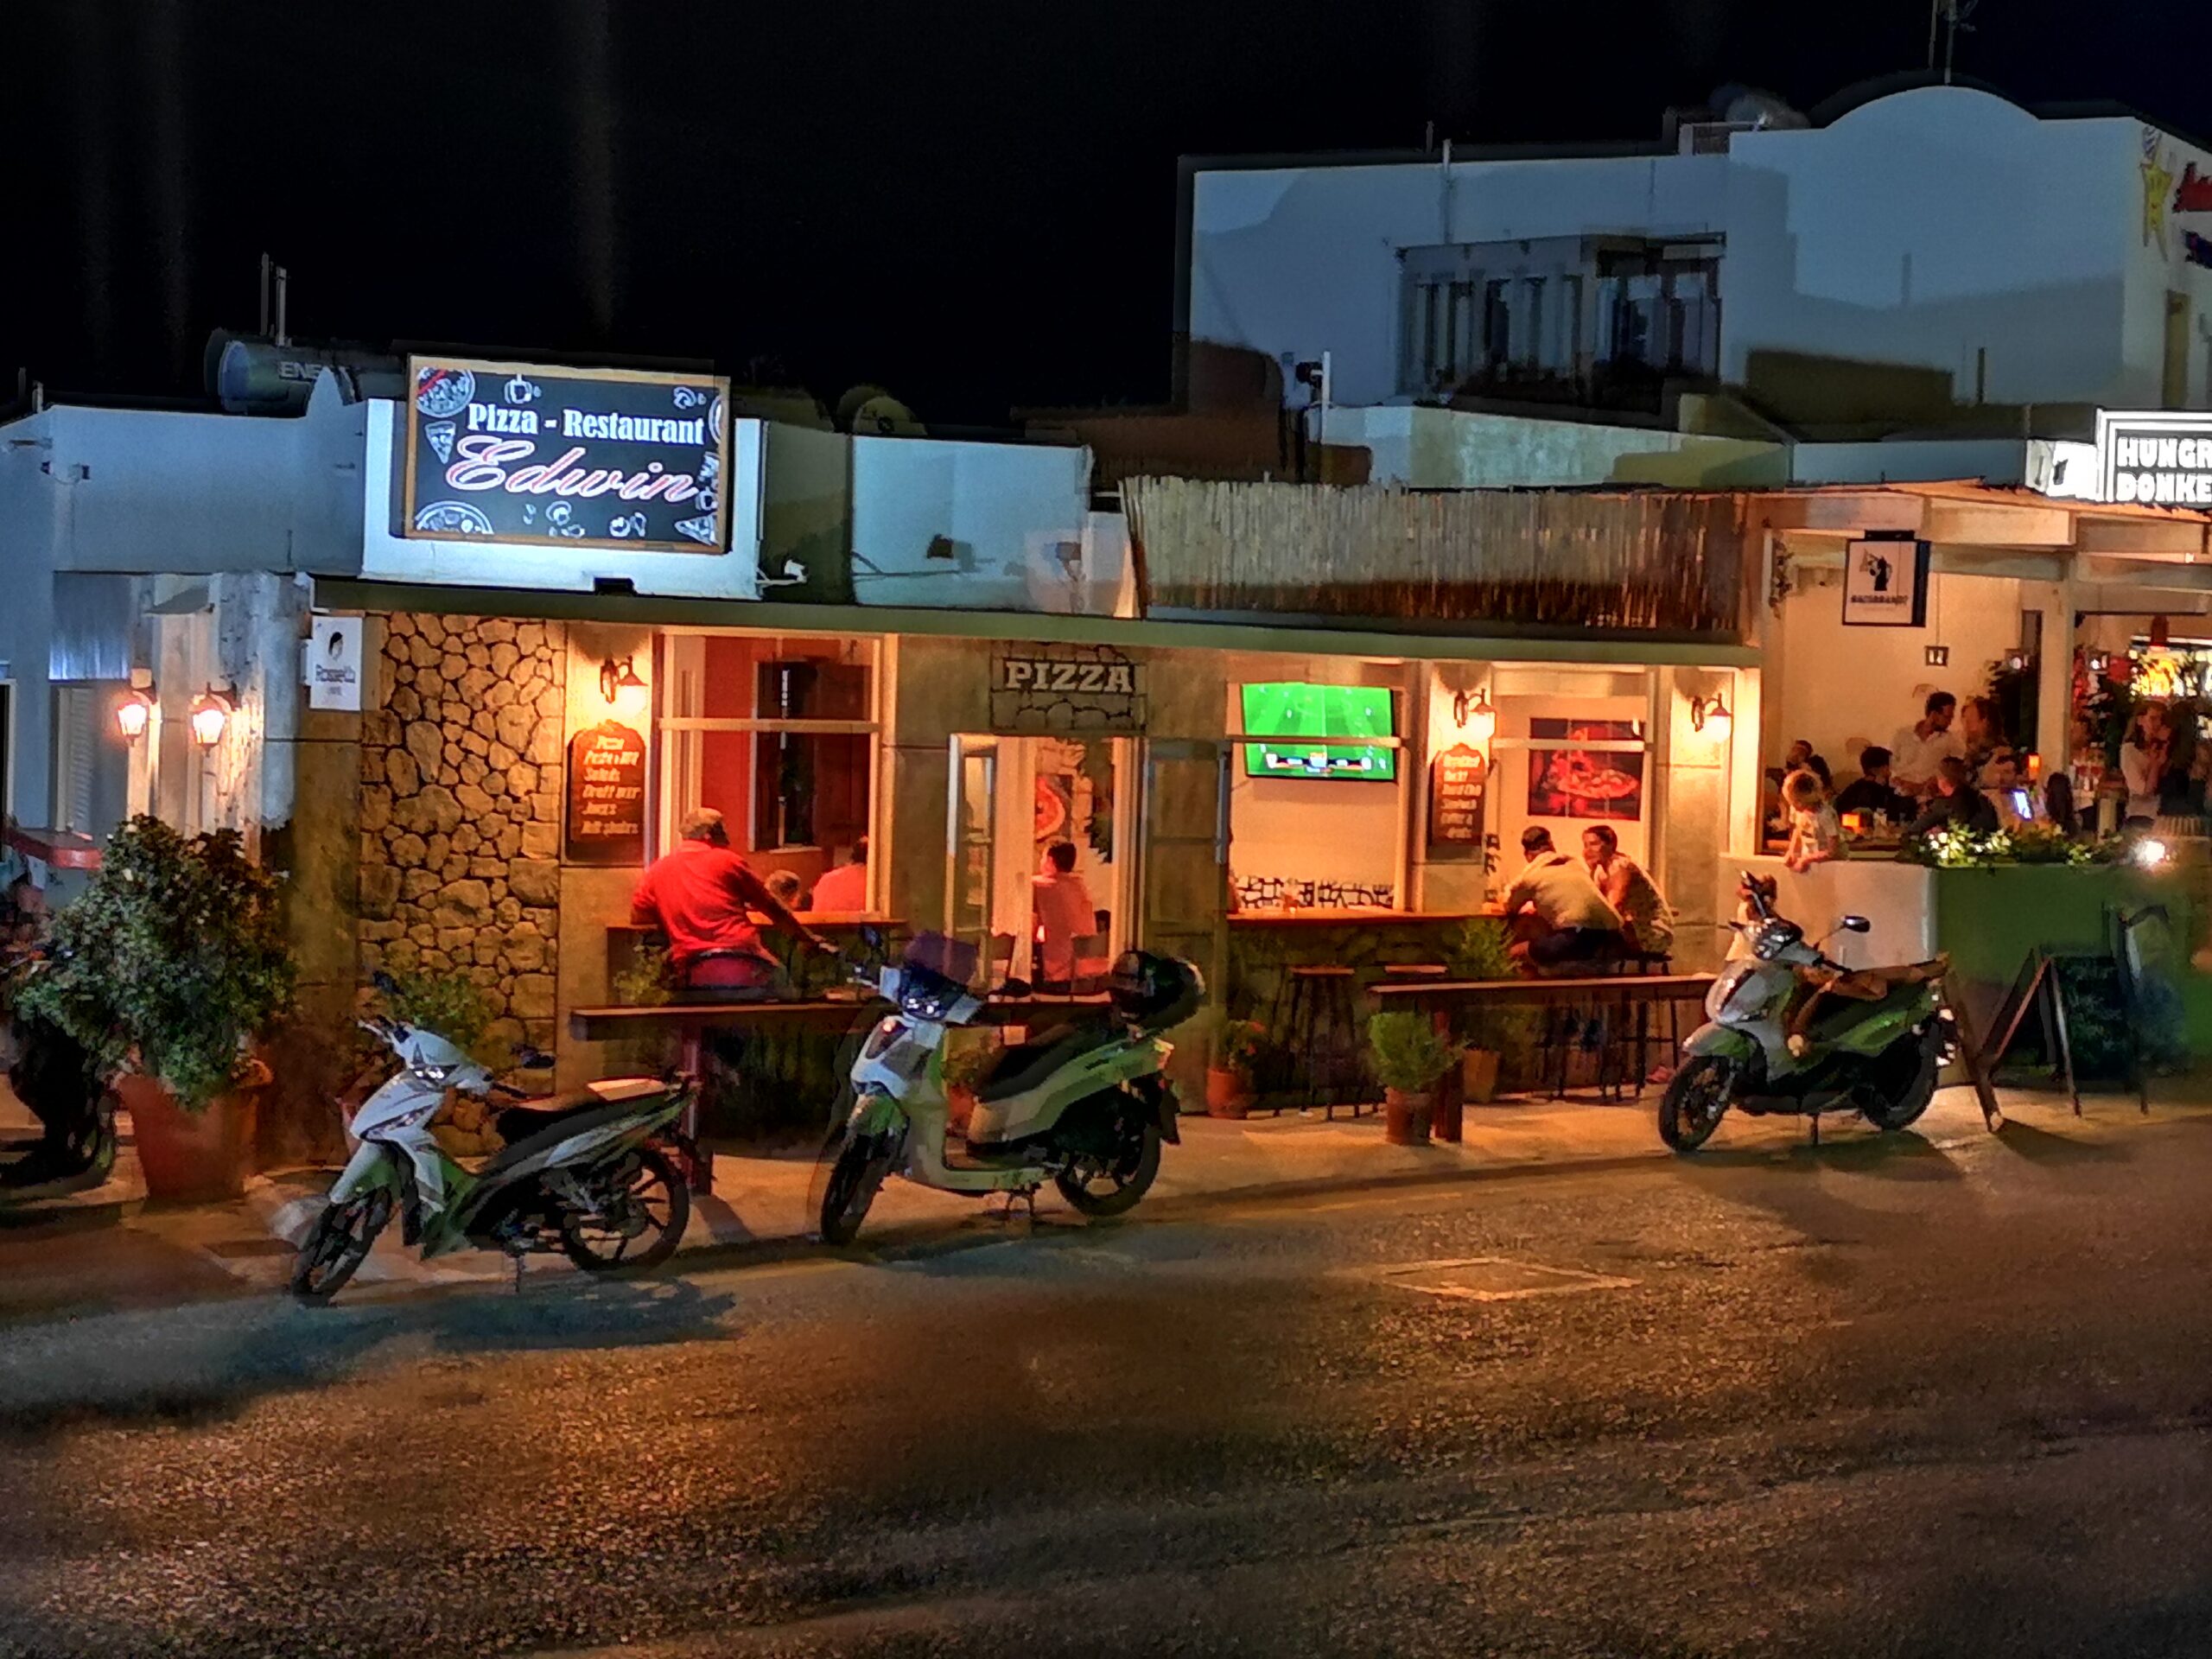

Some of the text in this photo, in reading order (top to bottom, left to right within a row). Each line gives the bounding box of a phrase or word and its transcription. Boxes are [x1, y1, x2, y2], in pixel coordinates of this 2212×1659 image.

[468, 403, 538, 435] Pizza
[563, 409, 705, 446] Restaurant
[446, 435, 700, 503] Edwin
[1005, 660, 1134, 693] PIZZA
